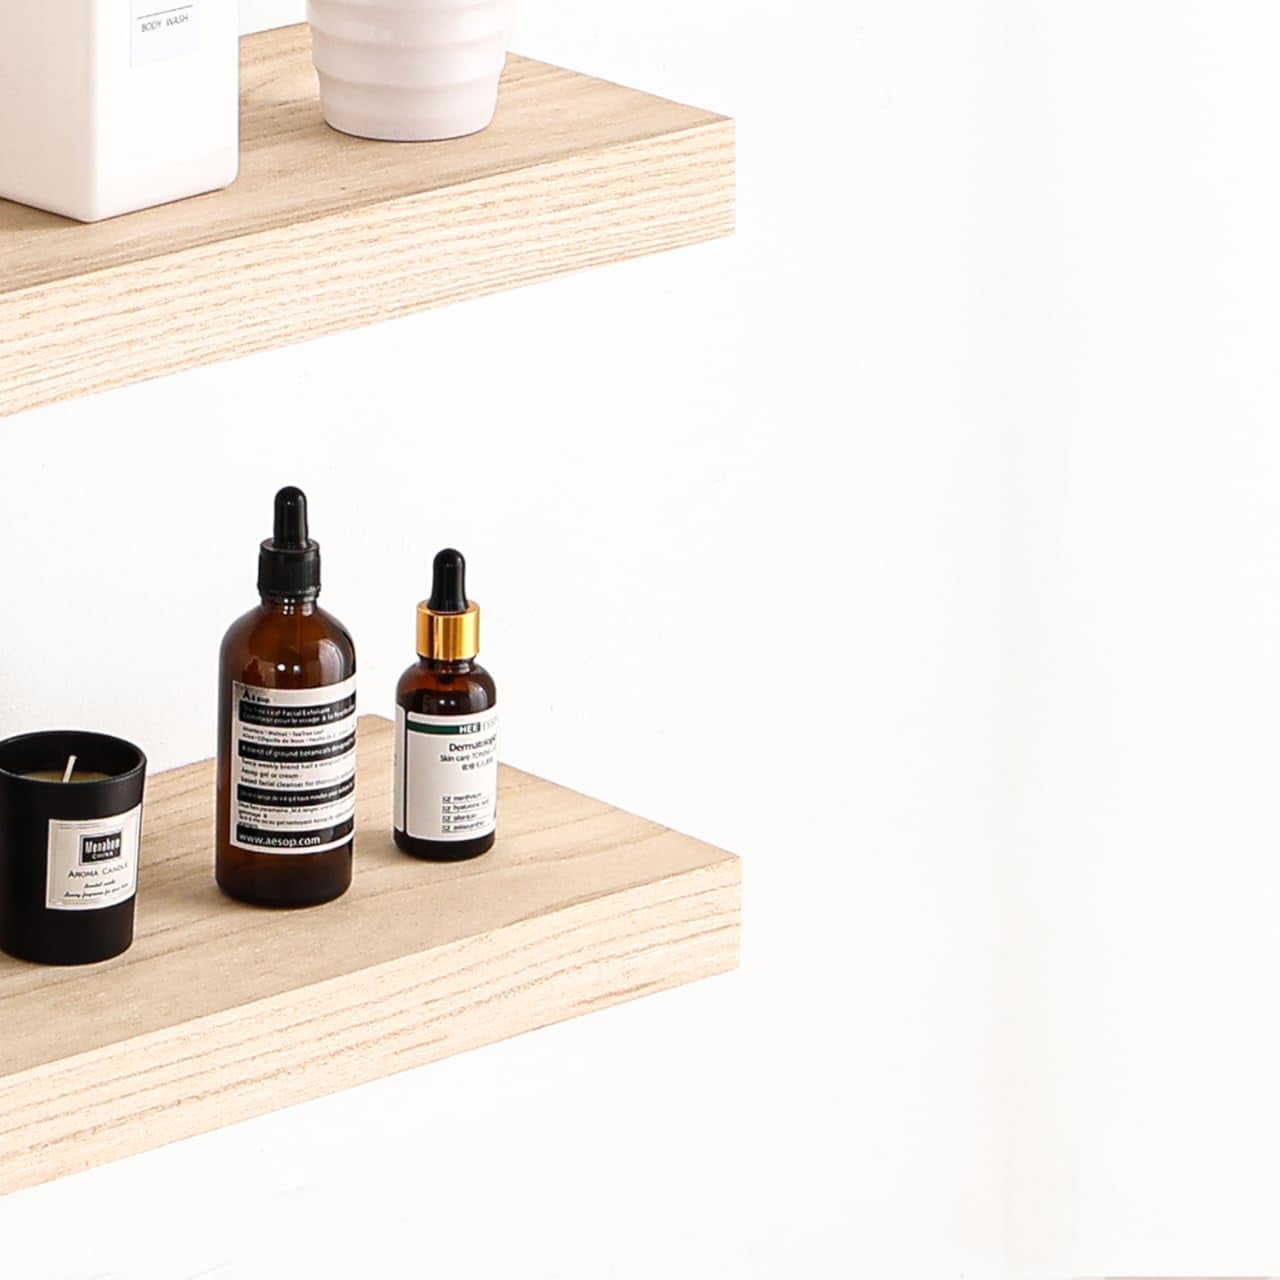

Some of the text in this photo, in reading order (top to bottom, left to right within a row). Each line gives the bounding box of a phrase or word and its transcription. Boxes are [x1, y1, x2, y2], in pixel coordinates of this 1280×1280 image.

[141, 13, 189, 33] BODY WASH
[239, 833, 321, 848] www.aesop.com
[67, 869, 99, 879] AROMA
